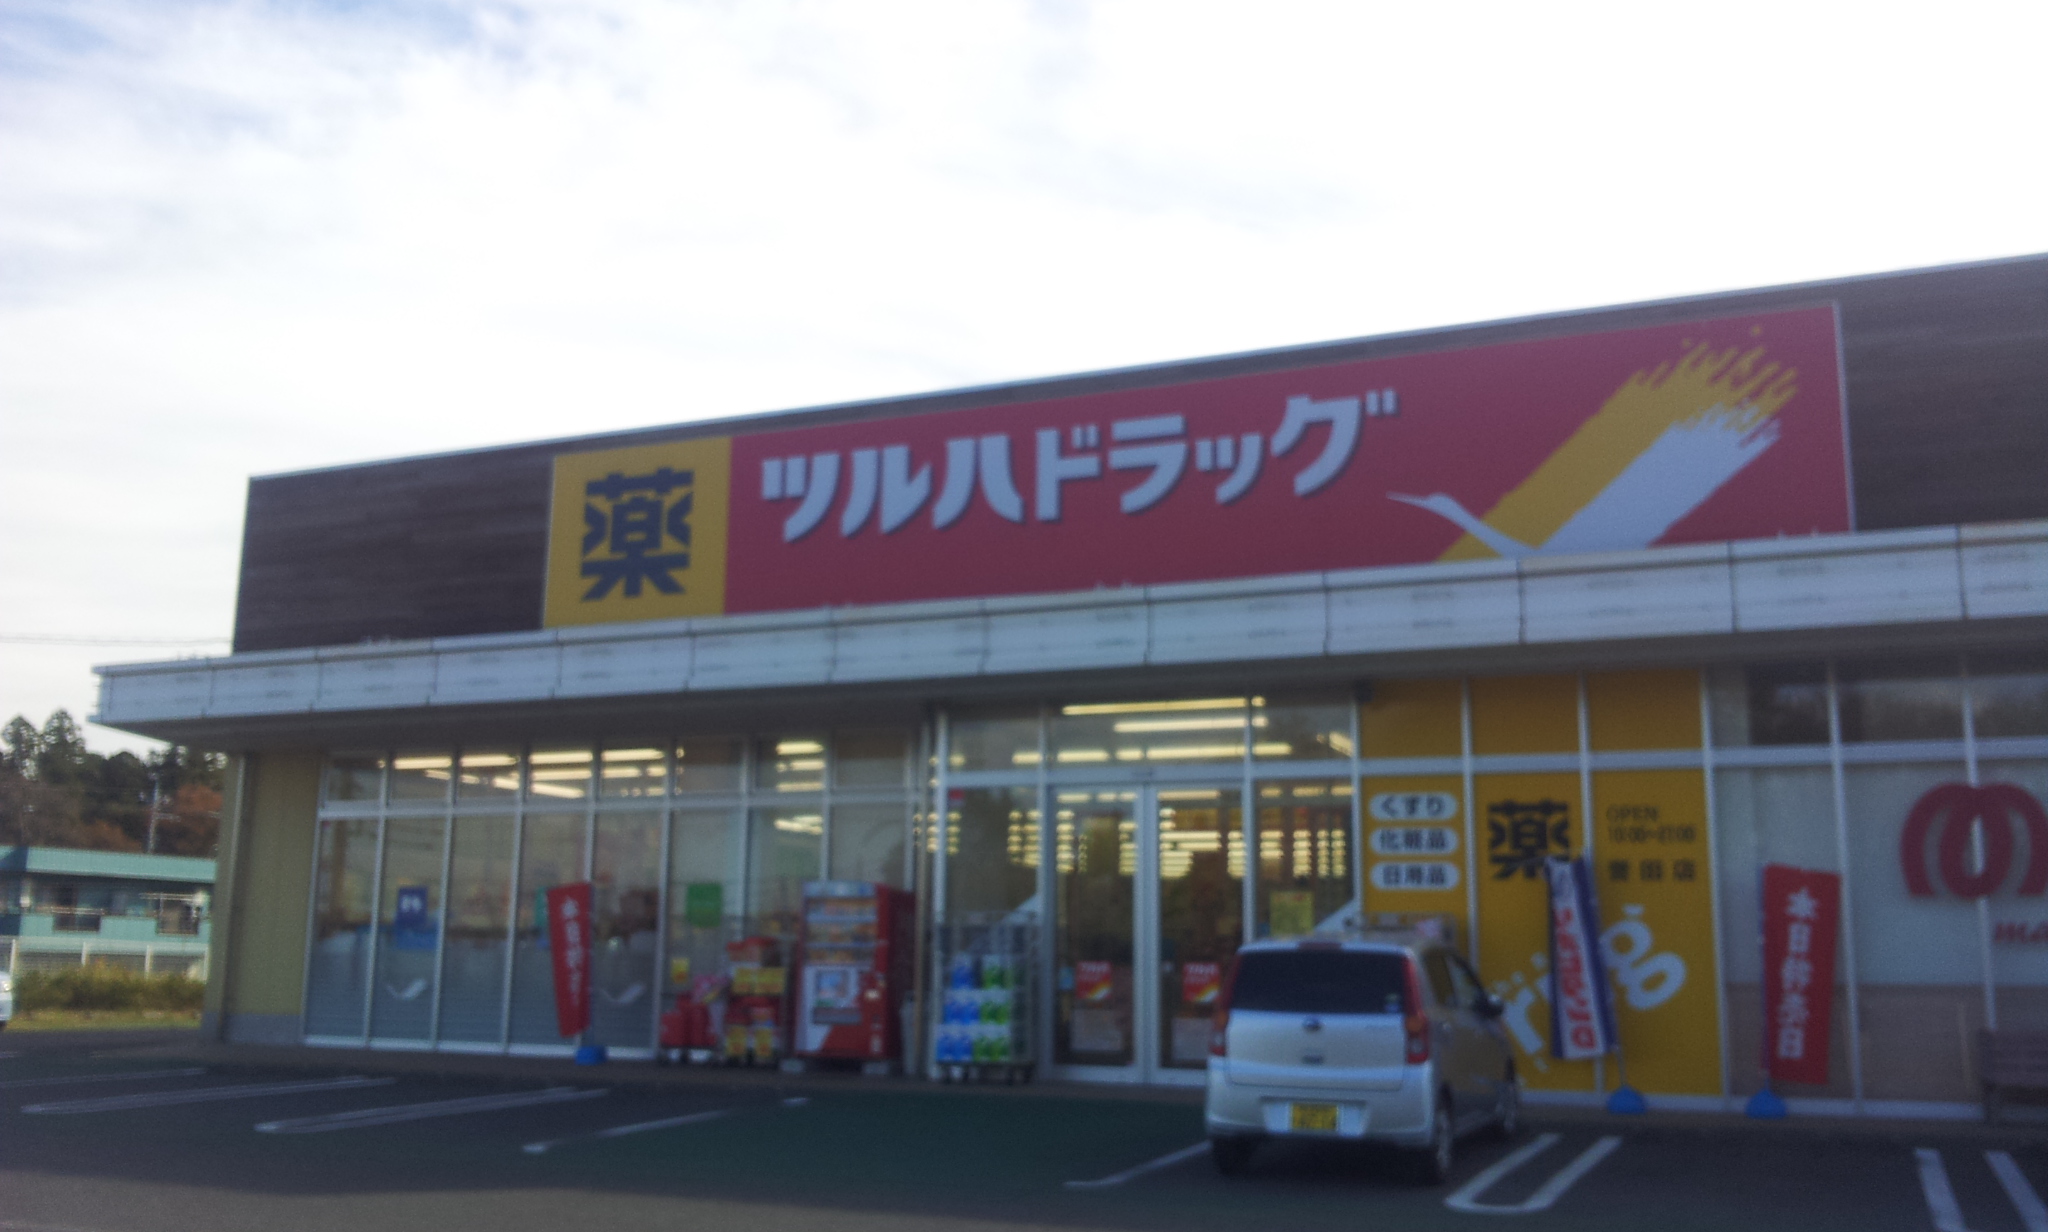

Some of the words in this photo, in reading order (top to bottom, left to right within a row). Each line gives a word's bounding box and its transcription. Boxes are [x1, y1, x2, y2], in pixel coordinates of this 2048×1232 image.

[762, 389, 1397, 542] ツルハドラッグ
[580, 467, 695, 602] 薬
[1381, 796, 1445, 817] くすり
[1607, 804, 1660, 822] OPEN
[1487, 799, 1572, 881] 薬
[1383, 864, 1446, 886] 日用品
